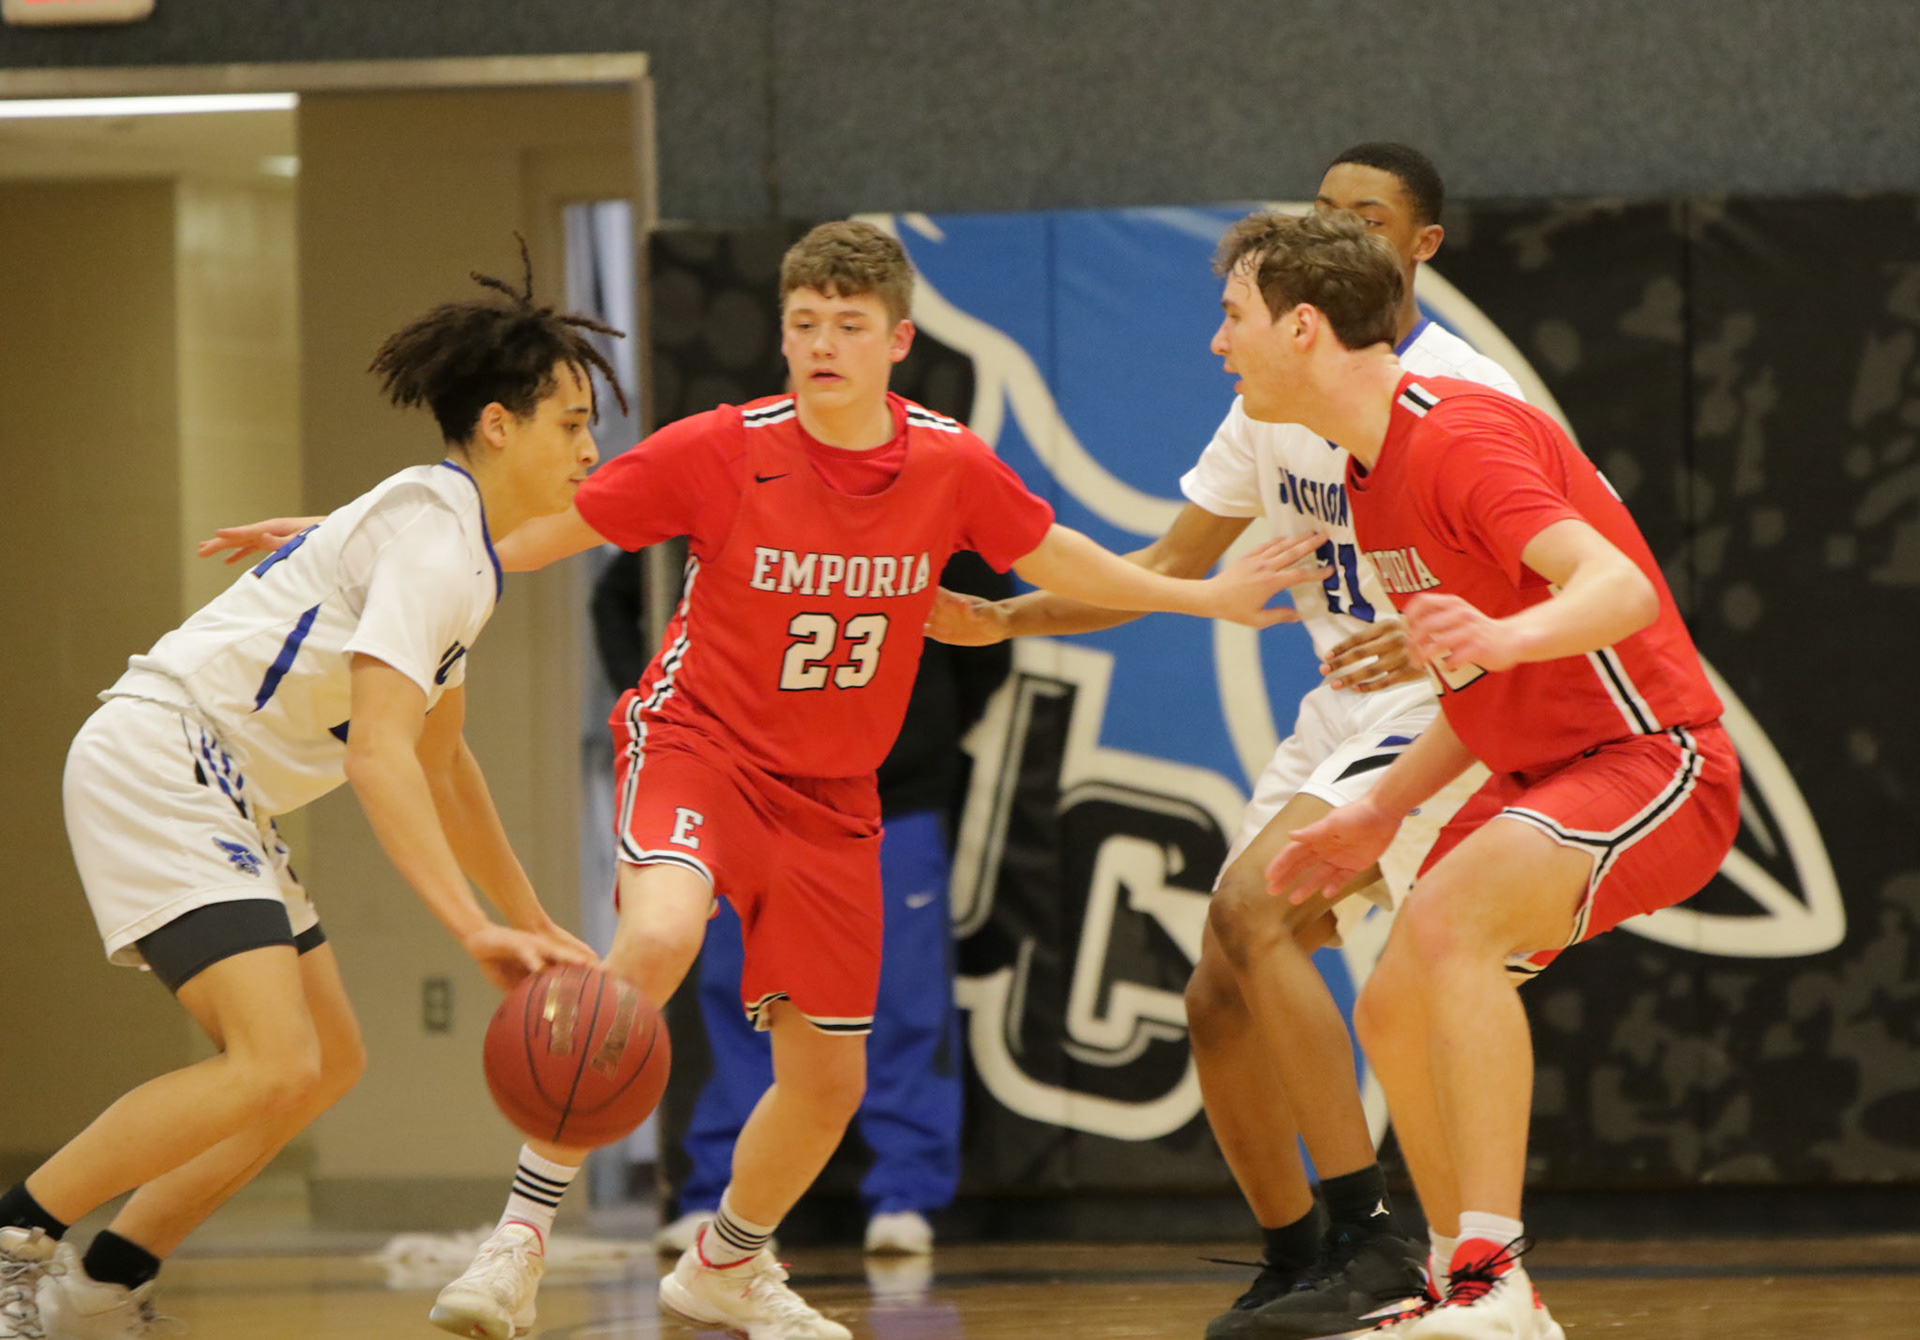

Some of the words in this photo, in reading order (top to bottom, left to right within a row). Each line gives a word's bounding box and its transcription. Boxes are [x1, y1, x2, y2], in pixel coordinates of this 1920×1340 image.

[750, 545, 931, 599] EMPORIA
[778, 611, 890, 692] 23
[668, 805, 705, 850] E
